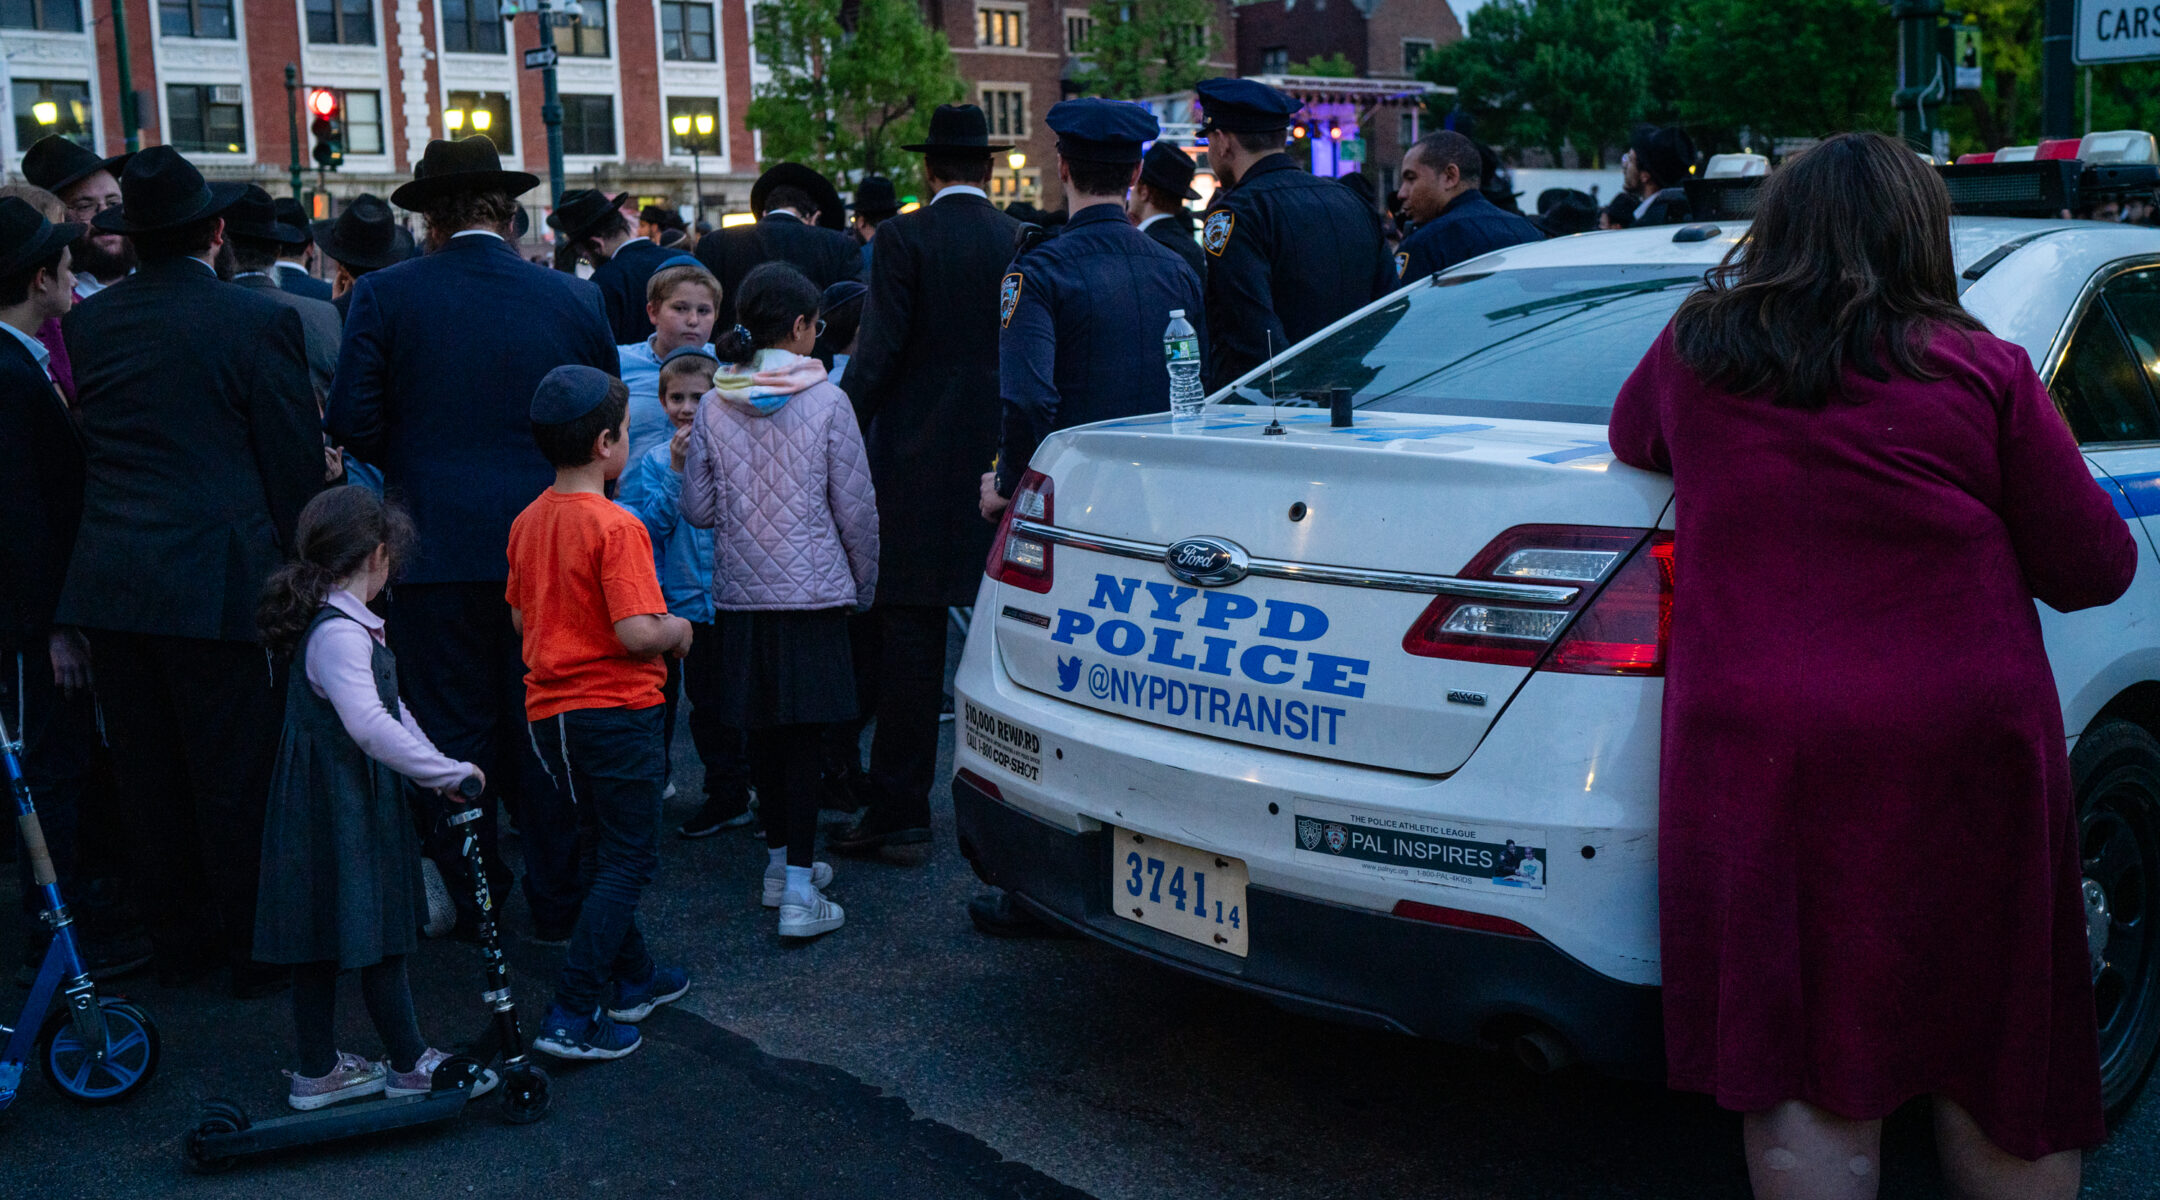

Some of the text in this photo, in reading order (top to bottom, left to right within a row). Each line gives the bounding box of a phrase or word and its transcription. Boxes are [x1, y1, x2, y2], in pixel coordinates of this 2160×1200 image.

[1177, 544, 1217, 568] Ford
[1088, 573, 1329, 642] NYPD
[1050, 608, 1370, 698] POLICE
[1088, 664, 1346, 745] @NYPDTRANSIT
[1448, 691, 1484, 704] AWD
[965, 702, 995, 734] $10,000
[997, 719, 1040, 754] REWARD
[966, 732, 978, 751] CALL
[978, 739, 993, 760] 1-800
[1350, 814, 1476, 839] THE POLICE ATHLETIC LEAGUE
[1352, 832, 1388, 854] PAL
[1393, 838, 1493, 868] INSPIRES
[1126, 851, 1240, 929] 3741 14
[1361, 862, 1473, 885] www.palnyc.org 1-800-PAL-4KIDS
